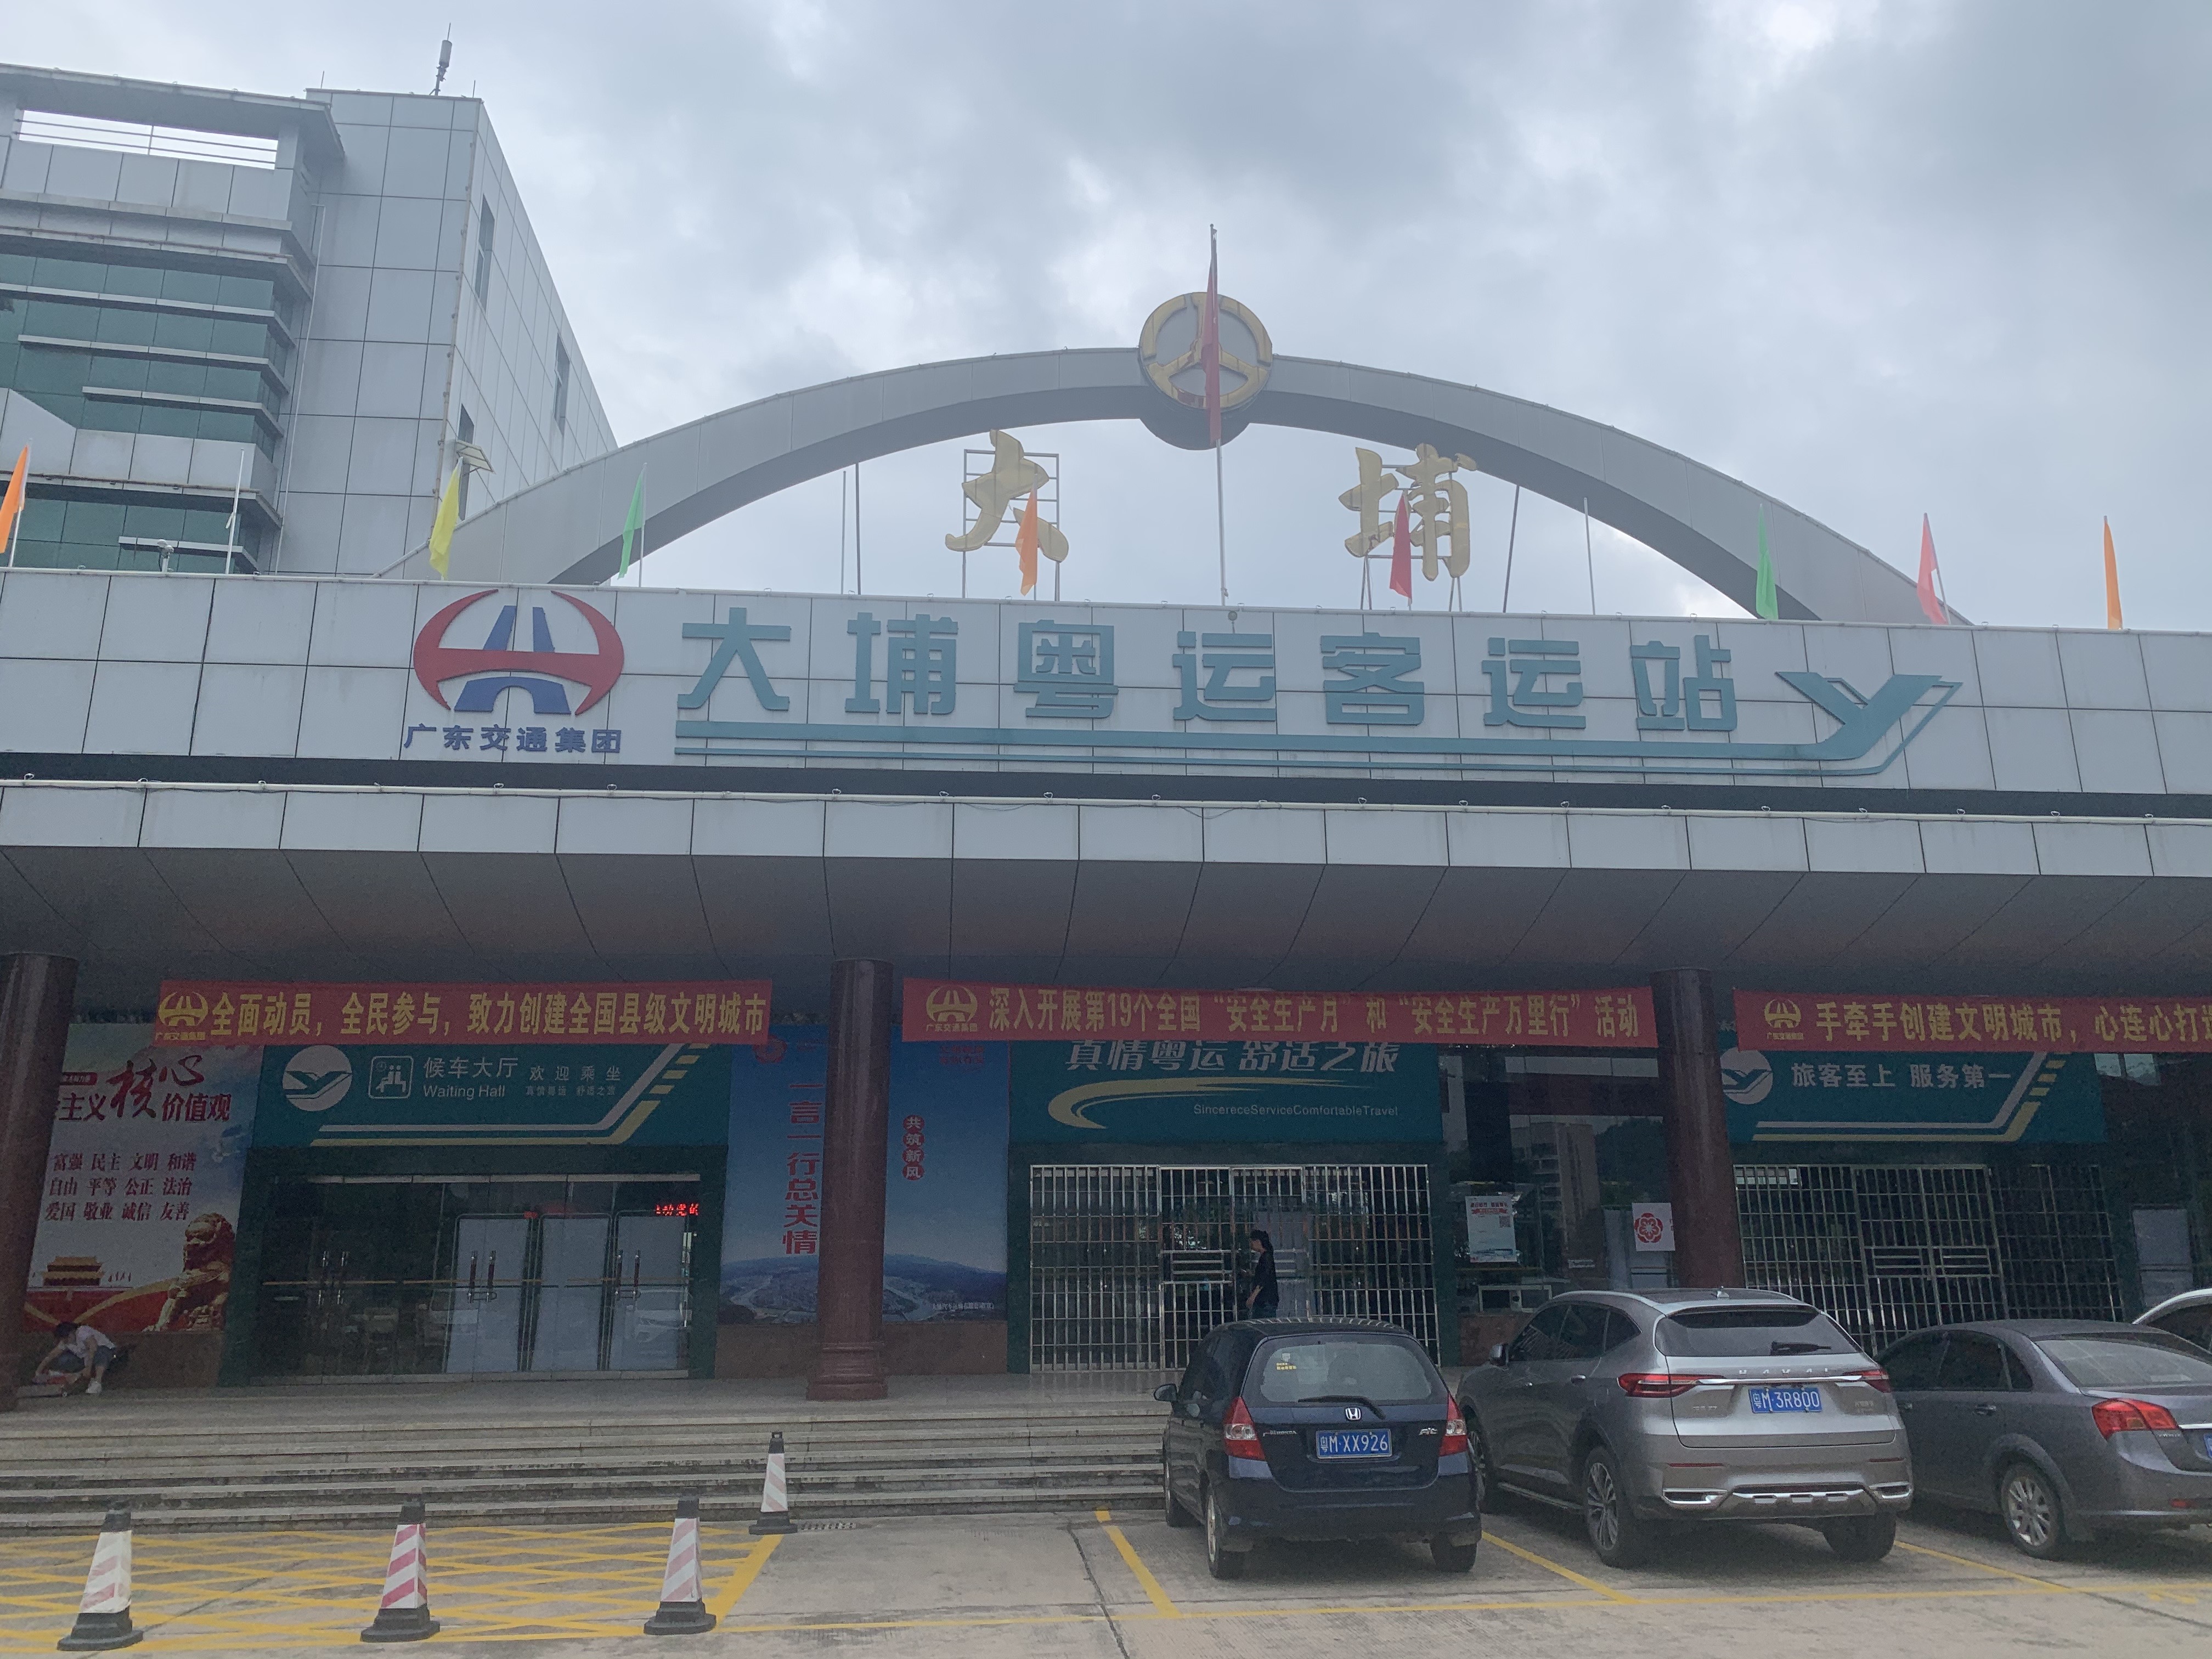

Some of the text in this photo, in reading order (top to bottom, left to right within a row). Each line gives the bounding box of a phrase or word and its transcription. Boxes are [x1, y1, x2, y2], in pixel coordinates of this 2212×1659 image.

[677, 606, 1737, 731] 大埔粤运客运站
[404, 722, 623, 753] 广东交通集团
[422, 1057, 519, 1079] 候车大厅
[529, 1065, 621, 1081] 欢迎乘坐
[1791, 1063, 2012, 1089] 旅客至上 服务第一
[423, 1085, 505, 1100] Waiting Hall
[57, 1092, 107, 1121] 主义
[162, 1093, 232, 1122] 价值观
[905, 1117, 923, 1179] 共筑新风
[53, 1152, 197, 1172] 富强 民主 文明 和谐
[782, 1082, 824, 1255] 一言一行总关情
[49, 1177, 193, 1197] 自由 平等 公正 法治
[44, 1202, 189, 1221] 爱国 敬业 诚信 友善
